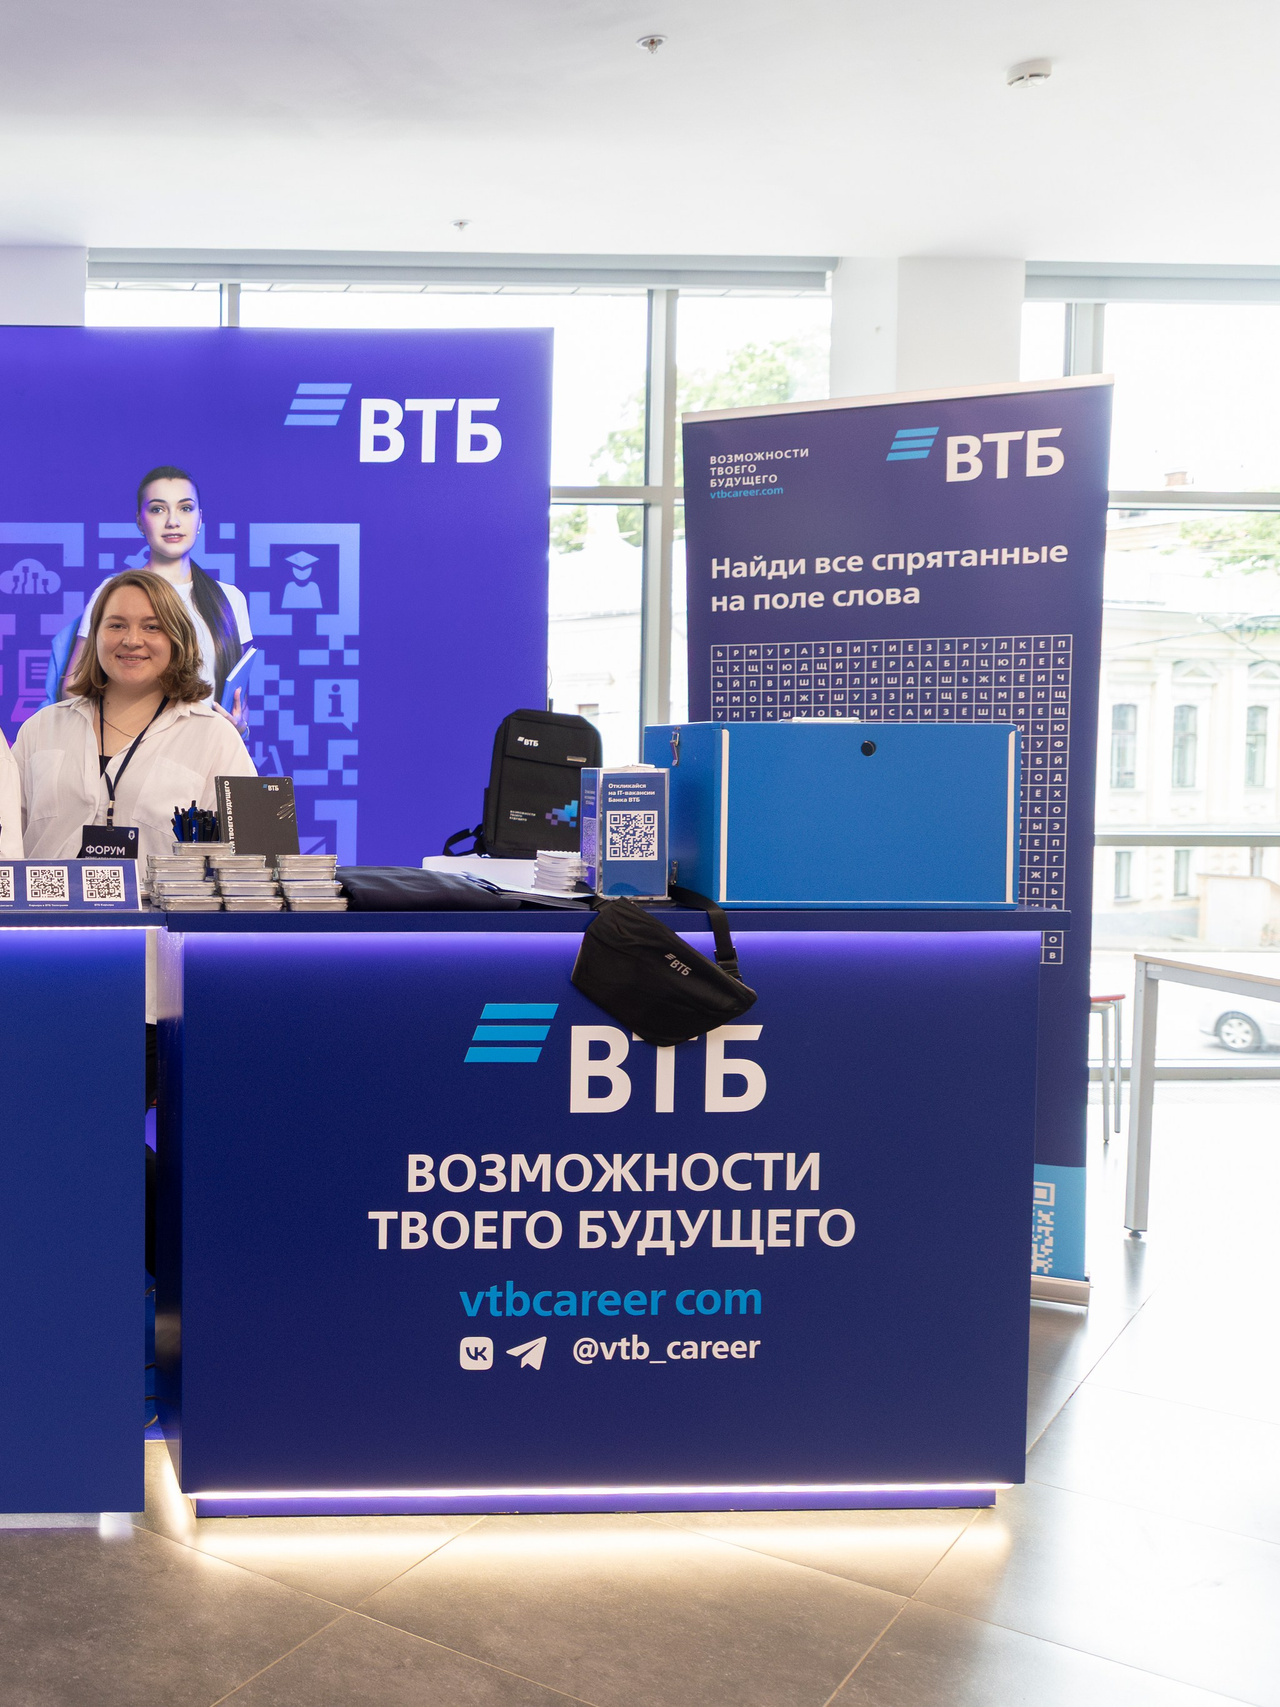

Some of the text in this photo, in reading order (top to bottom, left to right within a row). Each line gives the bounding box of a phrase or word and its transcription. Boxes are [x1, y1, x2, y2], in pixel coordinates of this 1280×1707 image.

[360, 398, 502, 462] ВТБ
[710, 448, 808, 464] ВОЗМОЖНОСТИ
[710, 464, 756, 476] ТВОЕГО
[946, 428, 1064, 482] ВТБ
[710, 474, 777, 488] БУДУЩЕГО
[710, 488, 783, 498] vtbcareer.com
[712, 545, 1068, 580] Найди все спрятанные
[712, 588, 920, 611] на поле слова
[224, 781, 232, 814] БУДУЩЕГО
[86, 845, 125, 855] ФОРУМ
[670, 959, 692, 976] ВТБ
[570, 1025, 768, 1114] ВТБ
[408, 1153, 820, 1192] ВОЗМОЖНОСТИ
[368, 1209, 855, 1256] ТВОЕГО БУДУЩЕГО
[574, 1334, 760, 1364] @vtb_career
